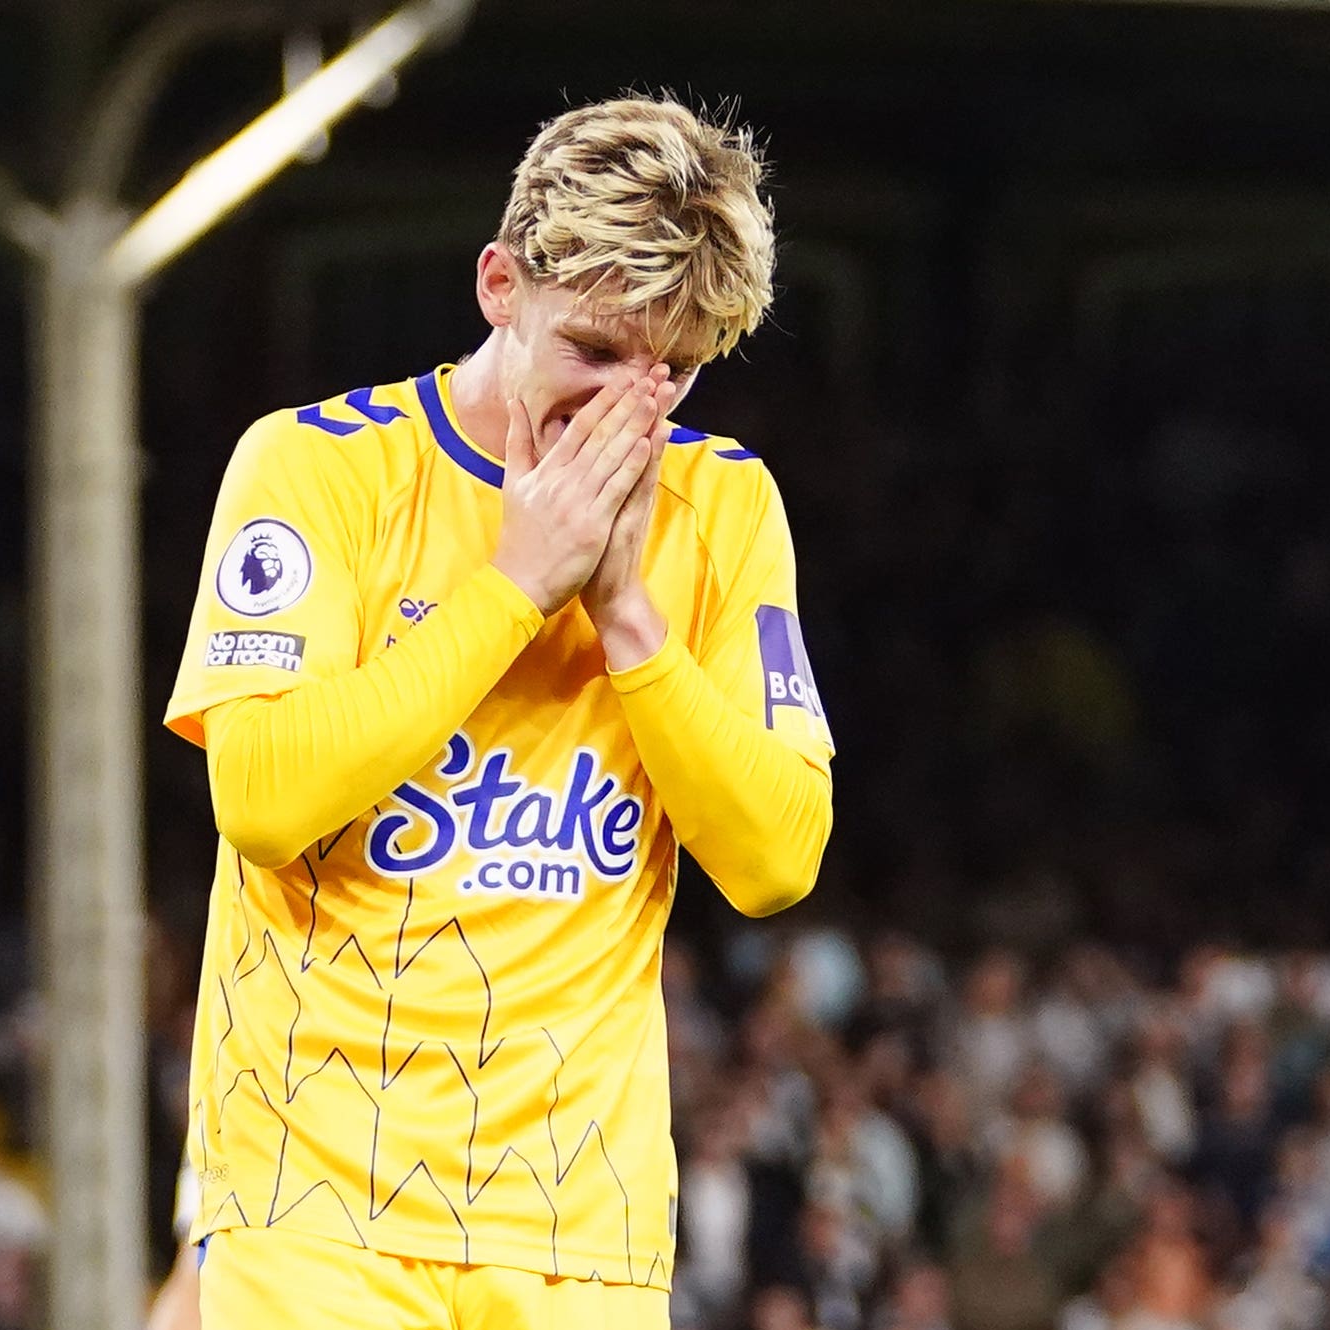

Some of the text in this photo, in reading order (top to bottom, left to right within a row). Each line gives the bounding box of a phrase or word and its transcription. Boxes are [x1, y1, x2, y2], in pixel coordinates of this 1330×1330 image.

[209, 632, 296, 654] No room
[368, 732, 642, 877] Stake
[462, 860, 580, 895] .com
